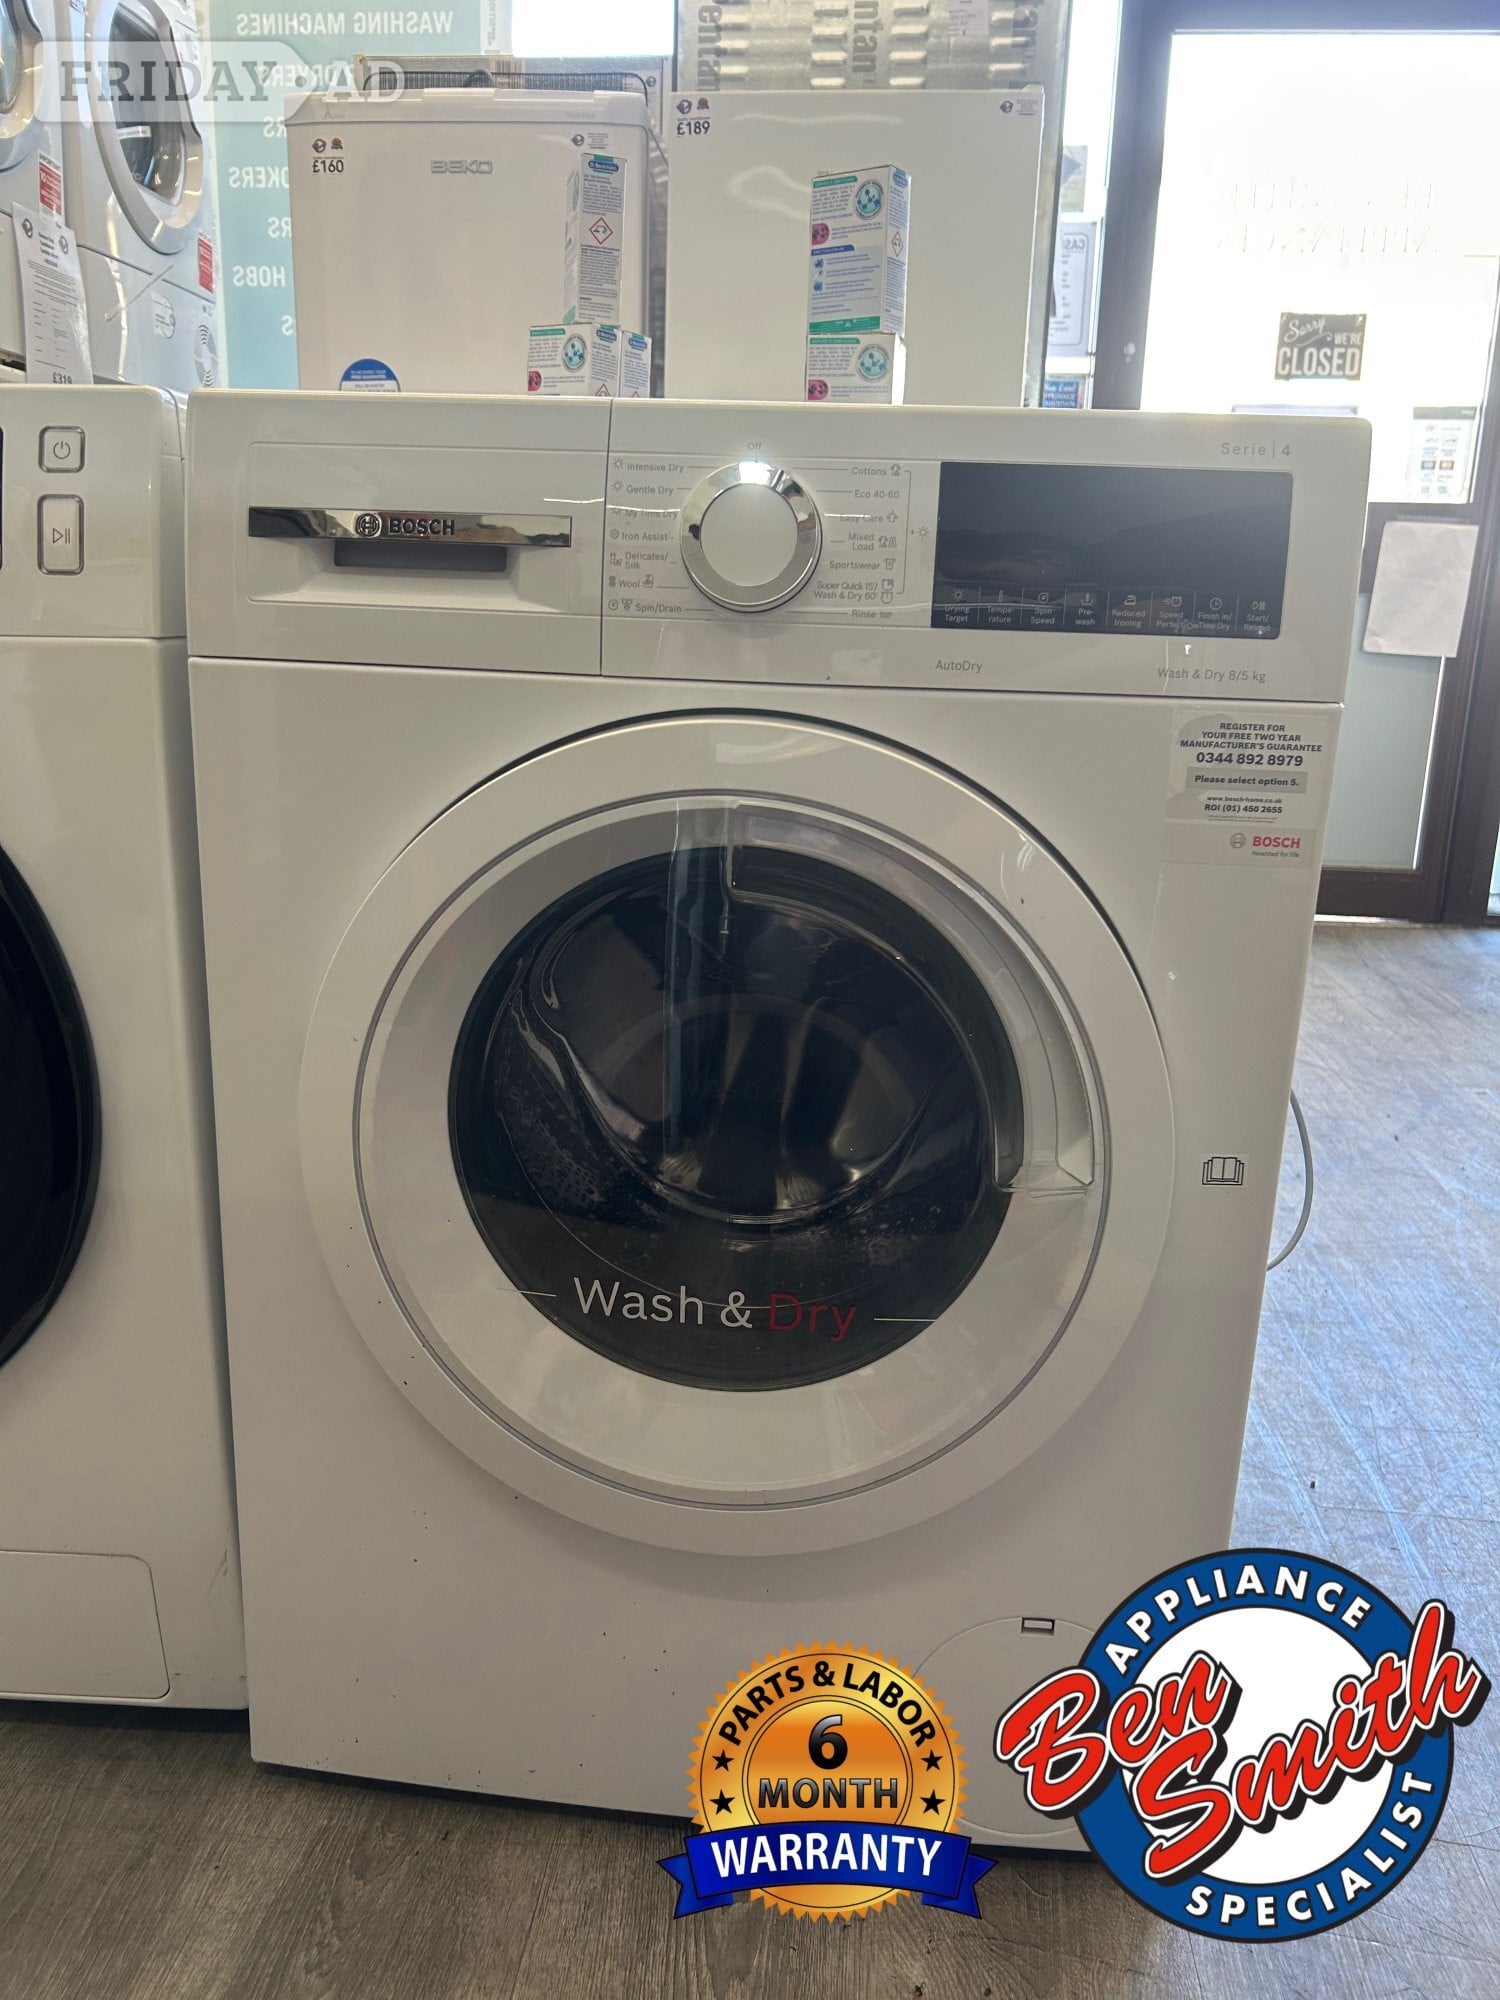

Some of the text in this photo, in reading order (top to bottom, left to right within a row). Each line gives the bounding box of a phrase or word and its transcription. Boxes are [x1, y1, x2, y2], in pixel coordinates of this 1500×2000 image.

[677, 120, 710, 136] £189
[312, 159, 344, 173] £160
[430, 159, 493, 174] BEKO
[1284, 317, 1325, 342] Sorry
[1334, 331, 1362, 345] WE'RE
[1277, 347, 1360, 376] CLOSED
[52, 371, 73, 384] £319
[1221, 442, 1291, 457] Serie 4
[627, 463, 684, 473] Intensive Dry
[851, 466, 887, 476] Cottons
[626, 484, 674, 496] Gentle Dry
[854, 489, 900, 499] Eco 40-60
[388, 518, 456, 537] BOSCH
[621, 531, 668, 541] Iron Assist
[848, 532, 875, 541] Mixed
[852, 542, 874, 551] Load
[625, 551, 669, 561] Delicates/
[625, 561, 641, 570] Silk
[829, 560, 880, 571] Sportswear
[618, 579, 641, 589] Wool
[816, 581, 840, 590] Super
[841, 581, 863, 590] Quick
[814, 590, 837, 599] Wash
[838, 591, 845, 600] &
[847, 591, 863, 602] Dry
[636, 602, 682, 613] Spin/Drain
[944, 604, 970, 614] Drying
[1034, 606, 1053, 615] Spin
[1078, 607, 1095, 616] Pre-
[851, 609, 876, 618] Rinse
[1111, 608, 1146, 618] Reduced
[1159, 610, 1184, 620] Speed
[1198, 612, 1221, 621] Finish
[1246, 613, 1270, 623] Start/
[944, 613, 969, 624] Target
[988, 615, 1012, 624] rature
[1030, 615, 1056, 625] Speed
[1075, 616, 1095, 625] wash
[1114, 618, 1142, 628] Ironing
[1199, 621, 1231, 632] Time Dry
[935, 659, 984, 674] AutoDry
[1157, 667, 1266, 684] Wash & Dry 8/5 kg
[1219, 722, 1285, 732] REGISTER FOR
[1202, 731, 1301, 742] YOUR FREE TWO YEAR
[1180, 740, 1323, 752] MANUFACTURER'S GUARANTEE
[1196, 752, 1304, 766] 0344 892 8979
[1194, 775, 1299, 787] Please select option 5.
[1204, 803, 1283, 814] ROI (01) 450 2655
[1252, 836, 1302, 849] BOSCH
[1279, 850, 1289, 858] for
[573, 1276, 857, 1342] Wash & Dry
